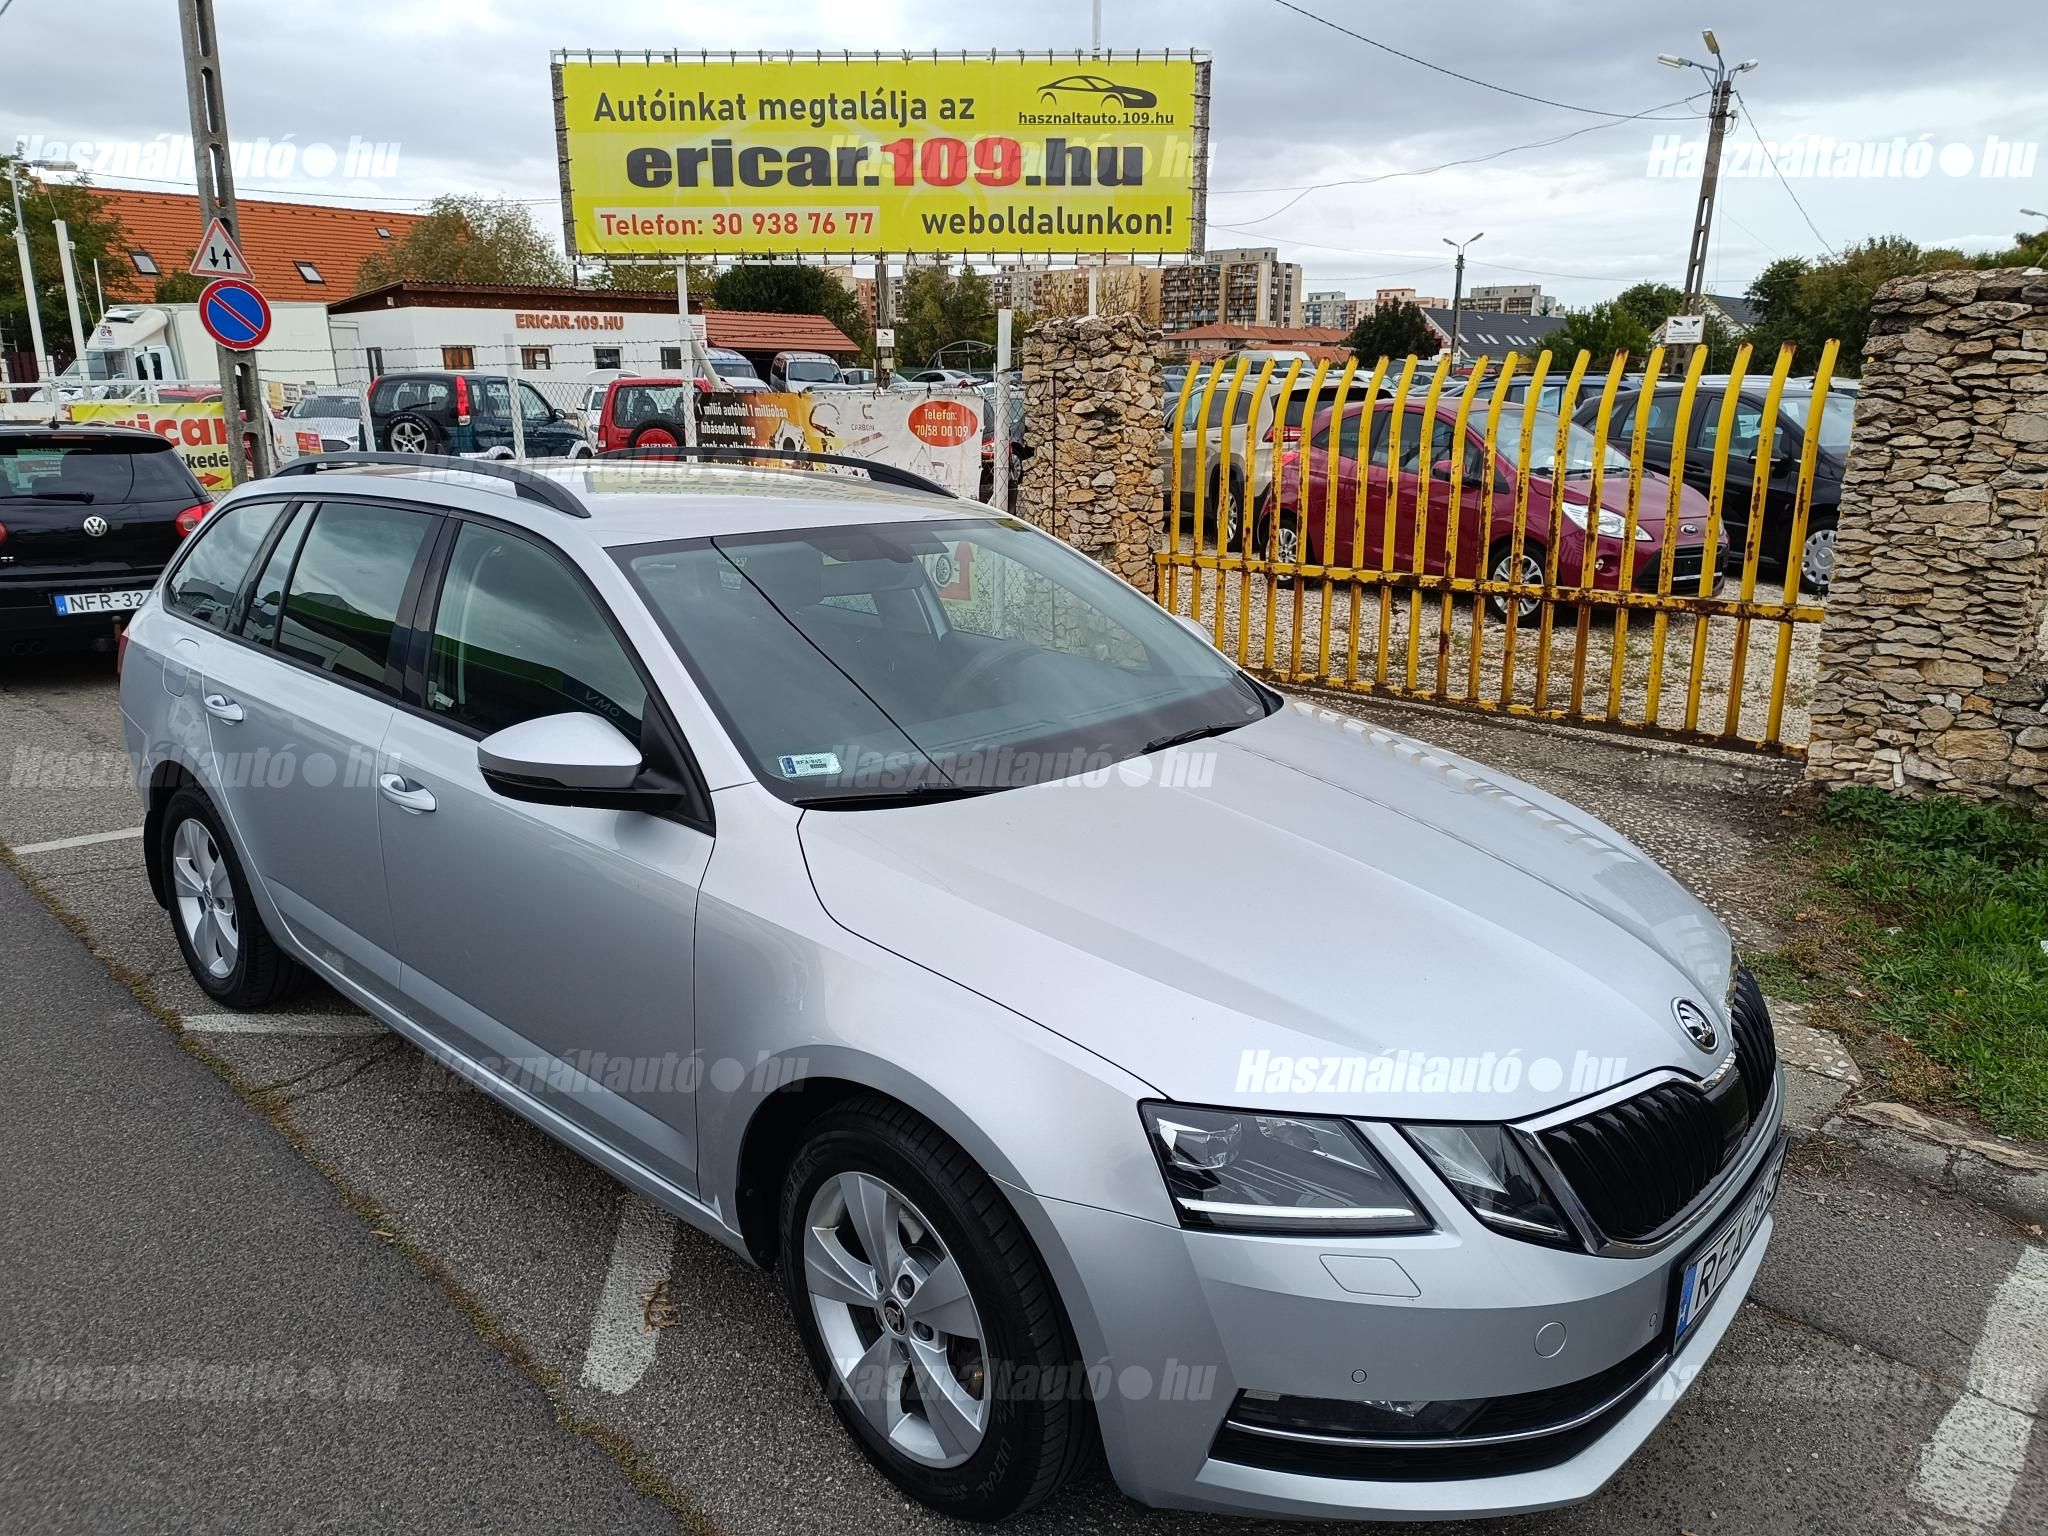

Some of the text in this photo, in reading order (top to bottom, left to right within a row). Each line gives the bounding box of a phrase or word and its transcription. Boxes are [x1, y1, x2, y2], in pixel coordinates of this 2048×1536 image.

[594, 86, 975, 128] Autóinkat megtalálja az
[1018, 111, 1175, 125] hasznaltauto.109.hu
[626, 137, 1144, 188] ericar.109.hu
[600, 212, 874, 235] Telefon: 30 938 76 77
[921, 205, 1173, 235] weboldalunkon!
[515, 313, 625, 331] ERICAR.109.HU
[924, 408, 958, 421] Telefon:
